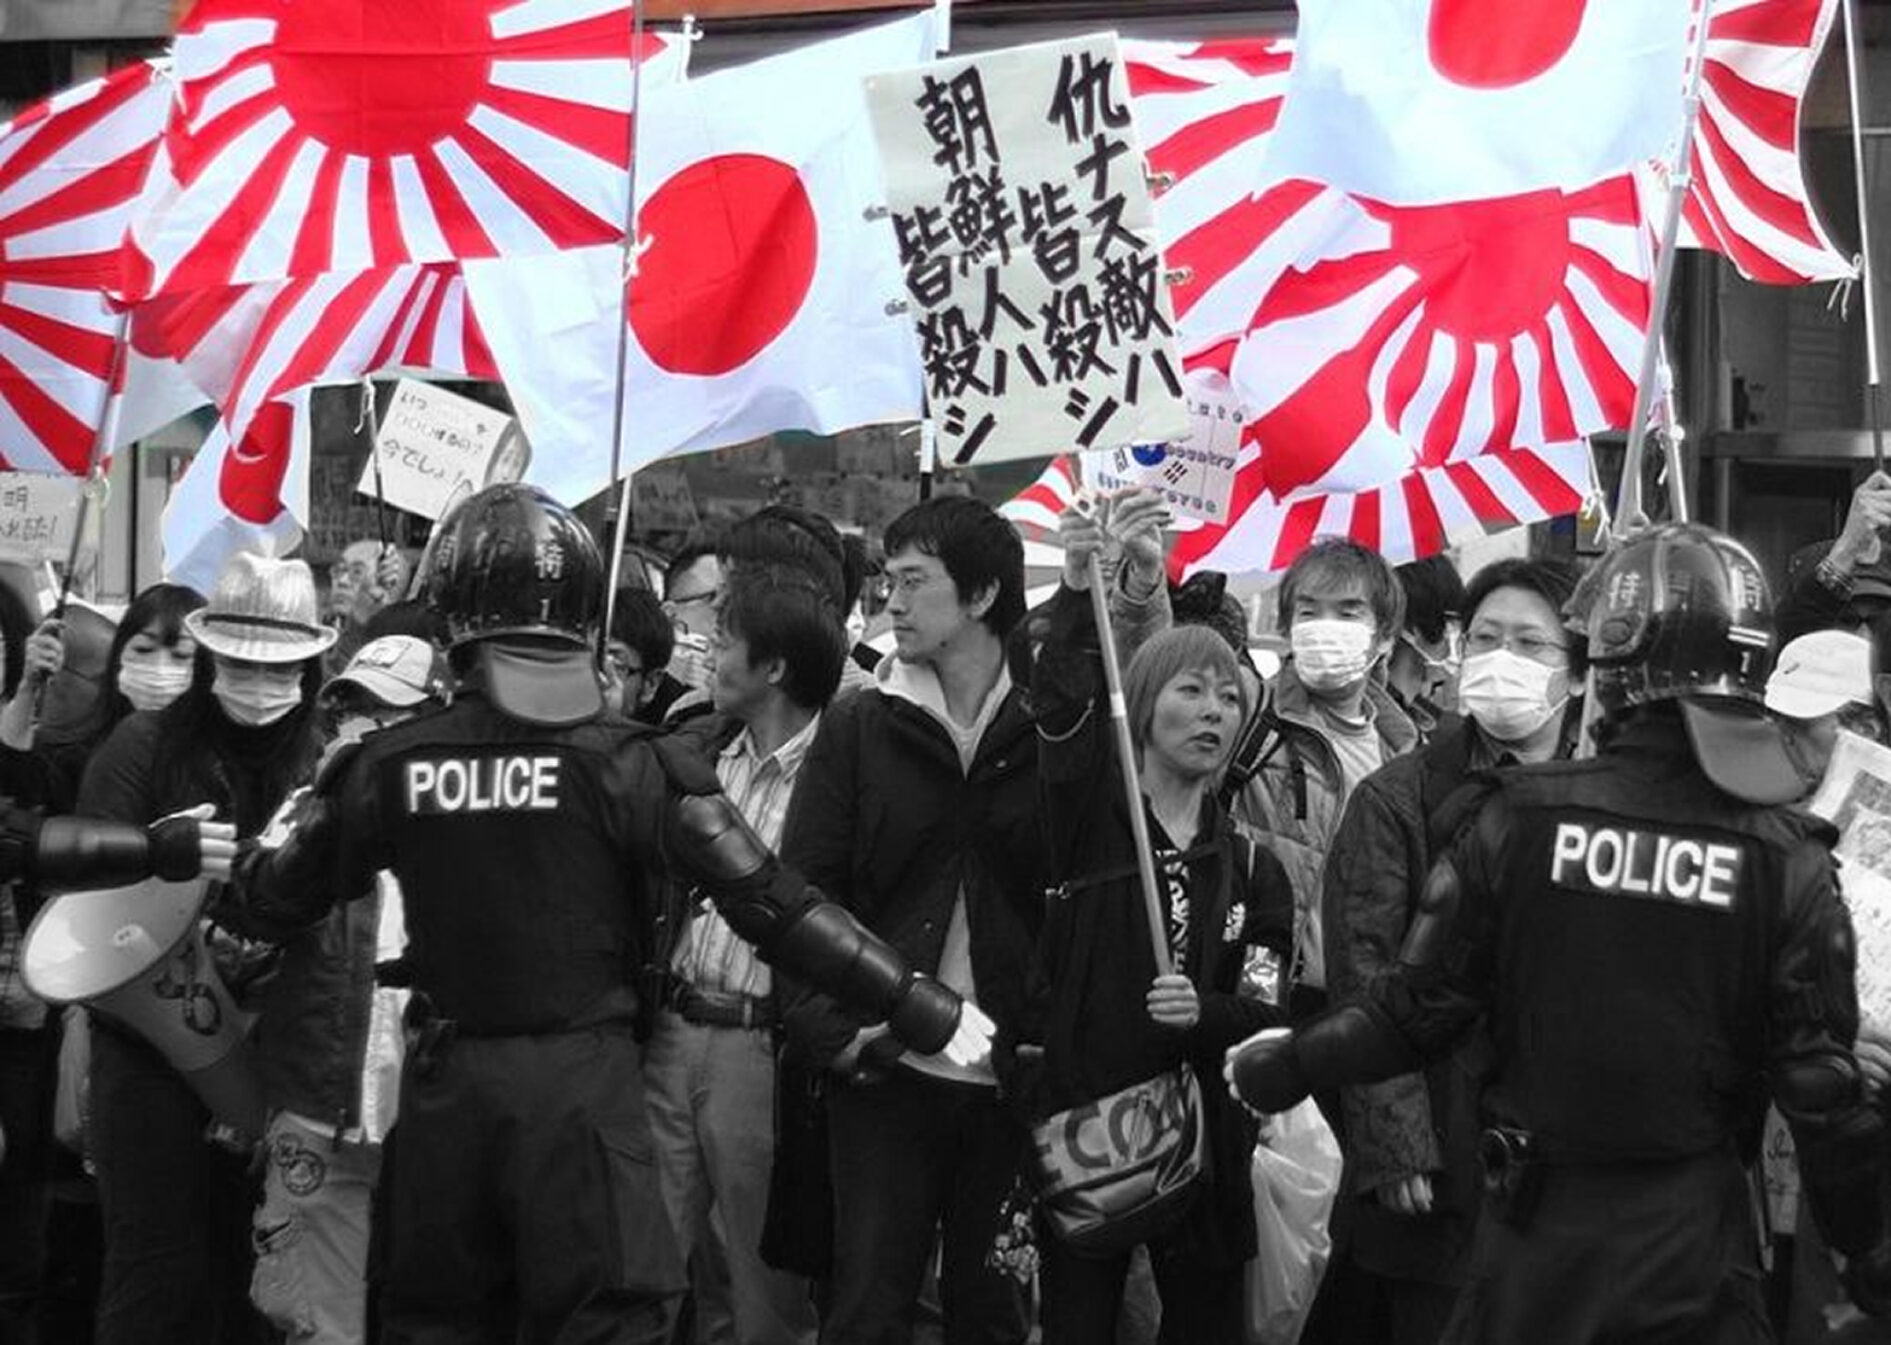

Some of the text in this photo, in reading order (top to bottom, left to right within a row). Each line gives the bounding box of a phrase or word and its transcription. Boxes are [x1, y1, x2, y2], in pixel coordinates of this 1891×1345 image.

[892, 206, 997, 464] 皆殺シ
[915, 65, 1048, 396] 朝鮮人ハ
[1017, 181, 1119, 448] 皆殺シ
[1047, 52, 1184, 404] 仇ナス敵ハ
[409, 757, 560, 813] POLICE
[1551, 822, 1740, 906] POLICE
